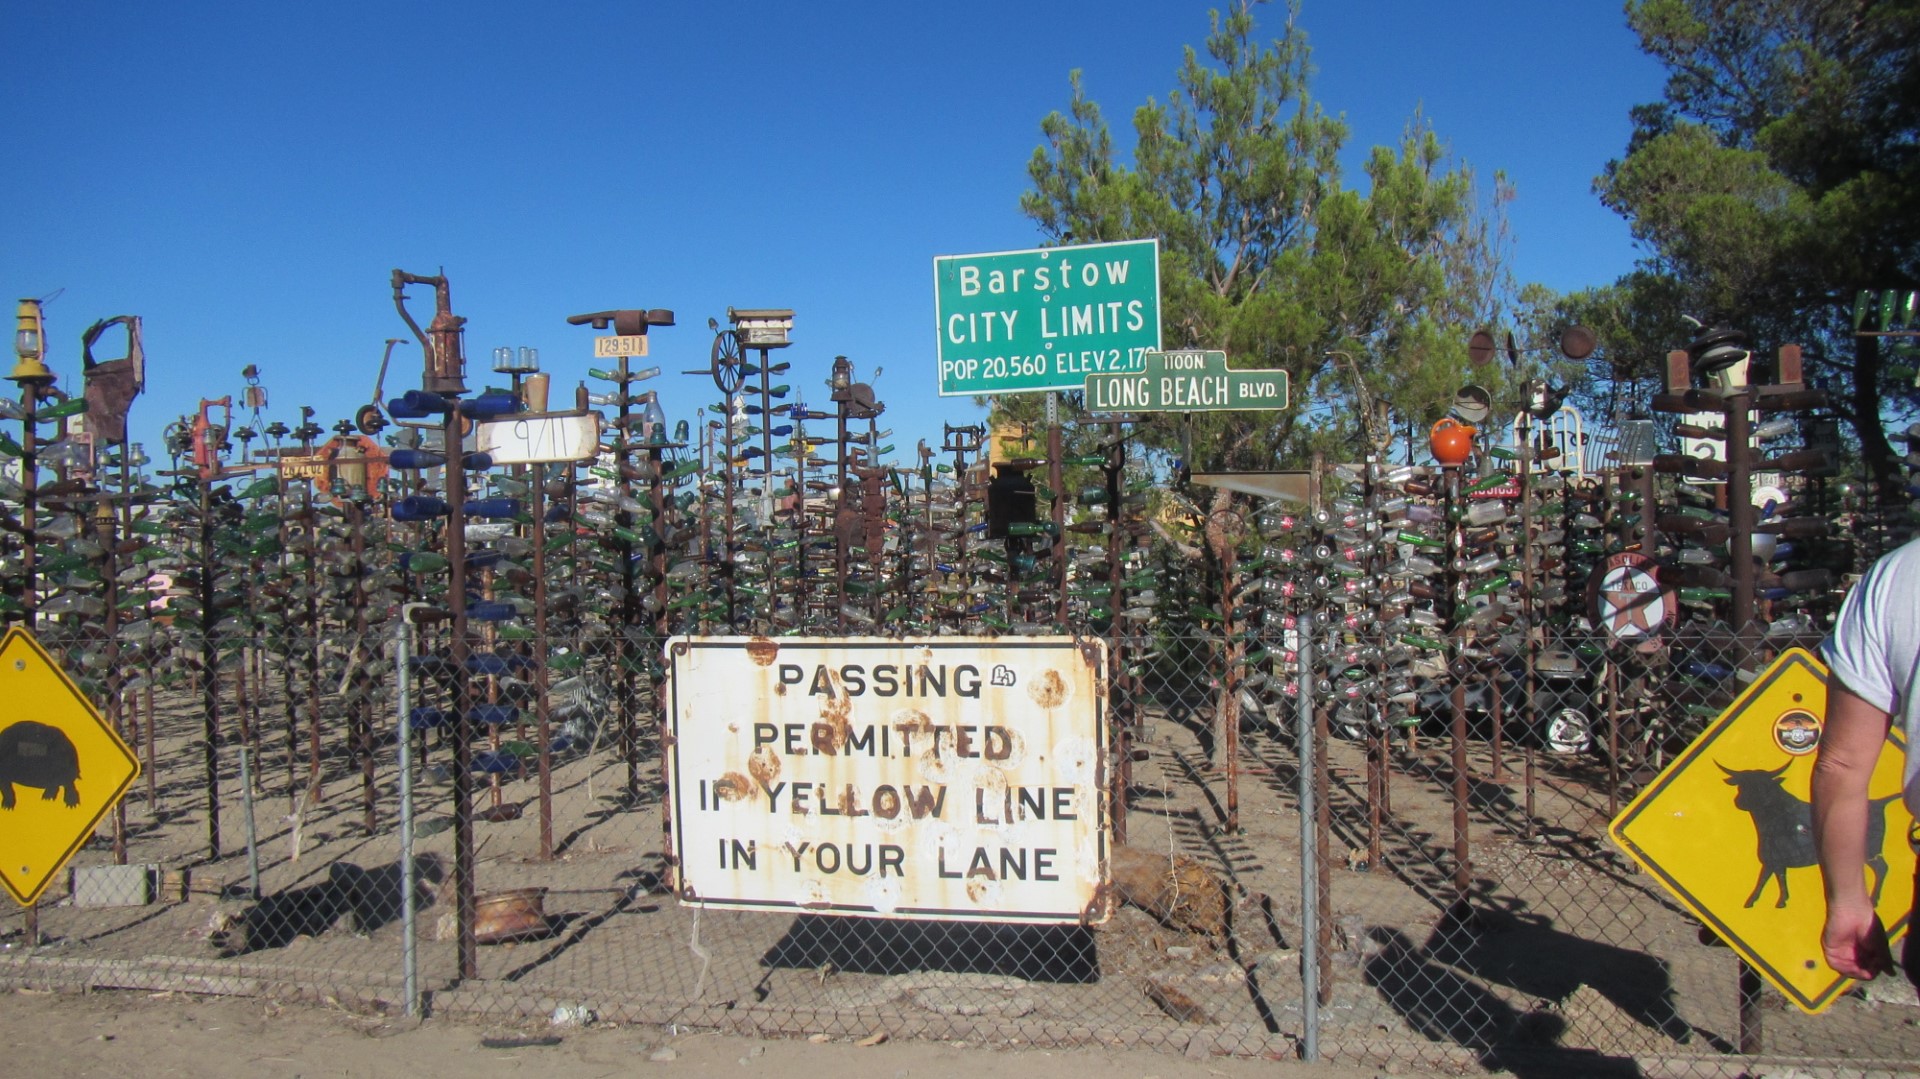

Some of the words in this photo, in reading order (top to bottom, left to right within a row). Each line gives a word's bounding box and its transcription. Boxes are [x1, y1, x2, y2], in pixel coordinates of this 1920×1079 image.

[960, 258, 1129, 296] Barstow
[948, 310, 1018, 344] CITY
[1041, 300, 1144, 338] LIMITS
[982, 354, 1046, 379] 20,560
[1097, 378, 1149, 407] LONG
[1161, 376, 1229, 406] BEACH
[1239, 383, 1278, 399] BLVD.
[514, 416, 568, 459] 9/11
[778, 664, 983, 699] PASSING
[753, 722, 1014, 761] PERMITTED
[763, 781, 948, 821] YELLOW
[975, 786, 1078, 825] LINE
[718, 838, 757, 871] IN
[782, 841, 905, 877] YOUR
[938, 846, 1060, 882] LANE
